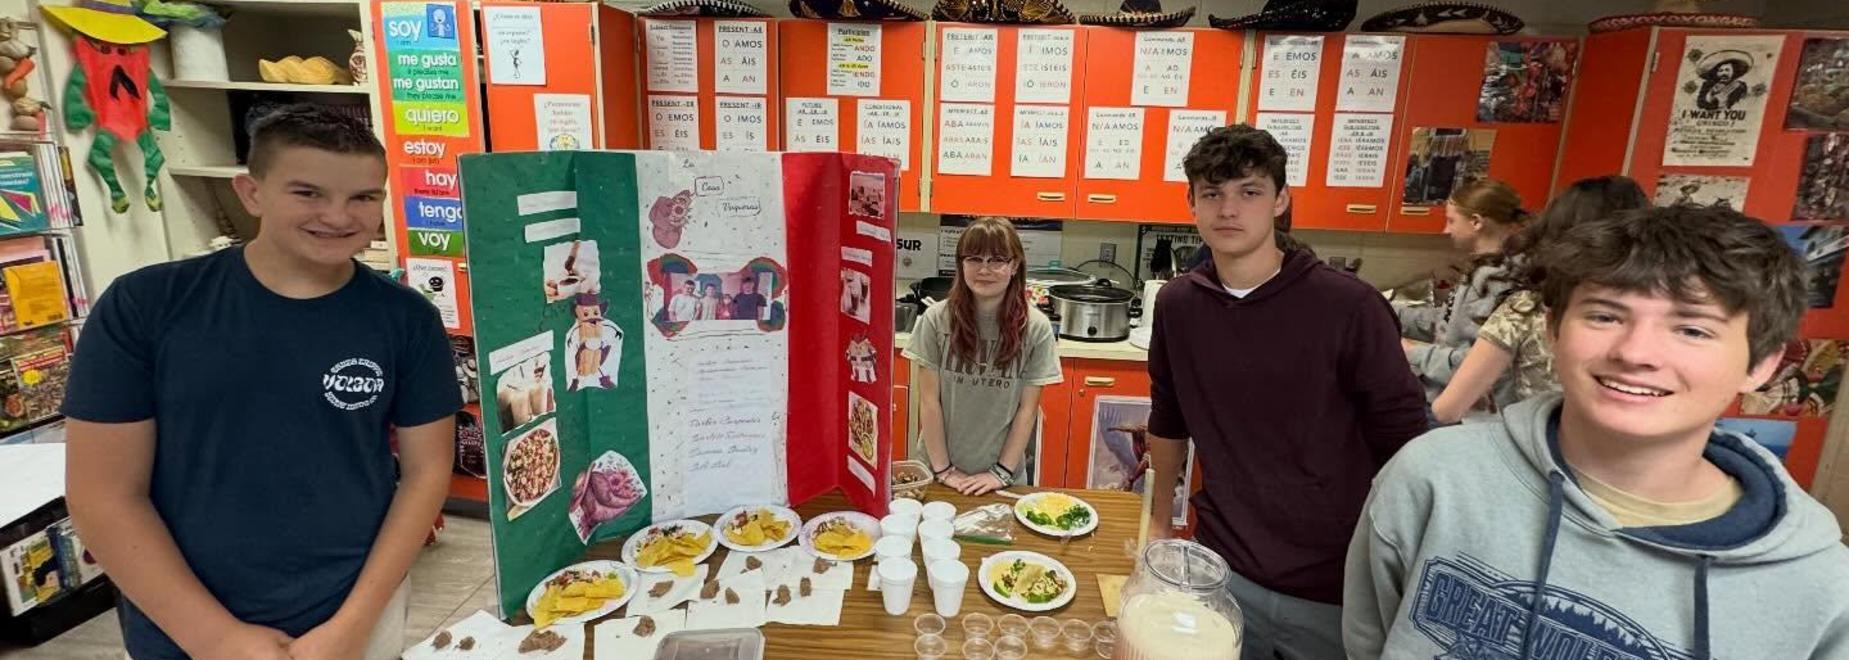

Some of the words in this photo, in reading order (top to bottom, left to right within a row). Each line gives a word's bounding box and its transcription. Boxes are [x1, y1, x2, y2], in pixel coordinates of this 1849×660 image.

[389, 20, 421, 41] soy
[722, 40, 730, 48] O
[735, 39, 763, 48] AMOS
[1041, 46, 1068, 56] IMOS
[398, 54, 418, 66] me
[421, 53, 457, 69] gusta
[856, 54, 873, 62] ADO
[1285, 51, 1317, 62] EMOS
[723, 74, 730, 82] A
[742, 75, 756, 83] AN
[1268, 70, 1281, 79] ES
[1346, 69, 1360, 78] AS
[393, 78, 412, 89] me
[416, 76, 459, 92] gustan
[1269, 88, 1275, 96] E
[1289, 88, 1304, 97] EN
[1346, 87, 1354, 96] A
[1368, 87, 1384, 96] AN
[406, 108, 459, 125] quiero
[655, 113, 663, 121] O
[724, 115, 731, 123] O
[737, 115, 762, 124] IMOS
[1682, 109, 1687, 119] I
[1690, 110, 1721, 120] WANT
[1724, 110, 1746, 121] YOU
[944, 120, 963, 128] ABA
[1112, 122, 1139, 130] AMOS
[404, 138, 446, 159] estoy
[943, 151, 963, 159] ABA
[425, 169, 457, 189] hay
[418, 232, 450, 251] voy
[896, 238, 922, 251] SUR
[972, 377, 1010, 389] UTERO
[1426, 572, 1519, 643] GREAT
